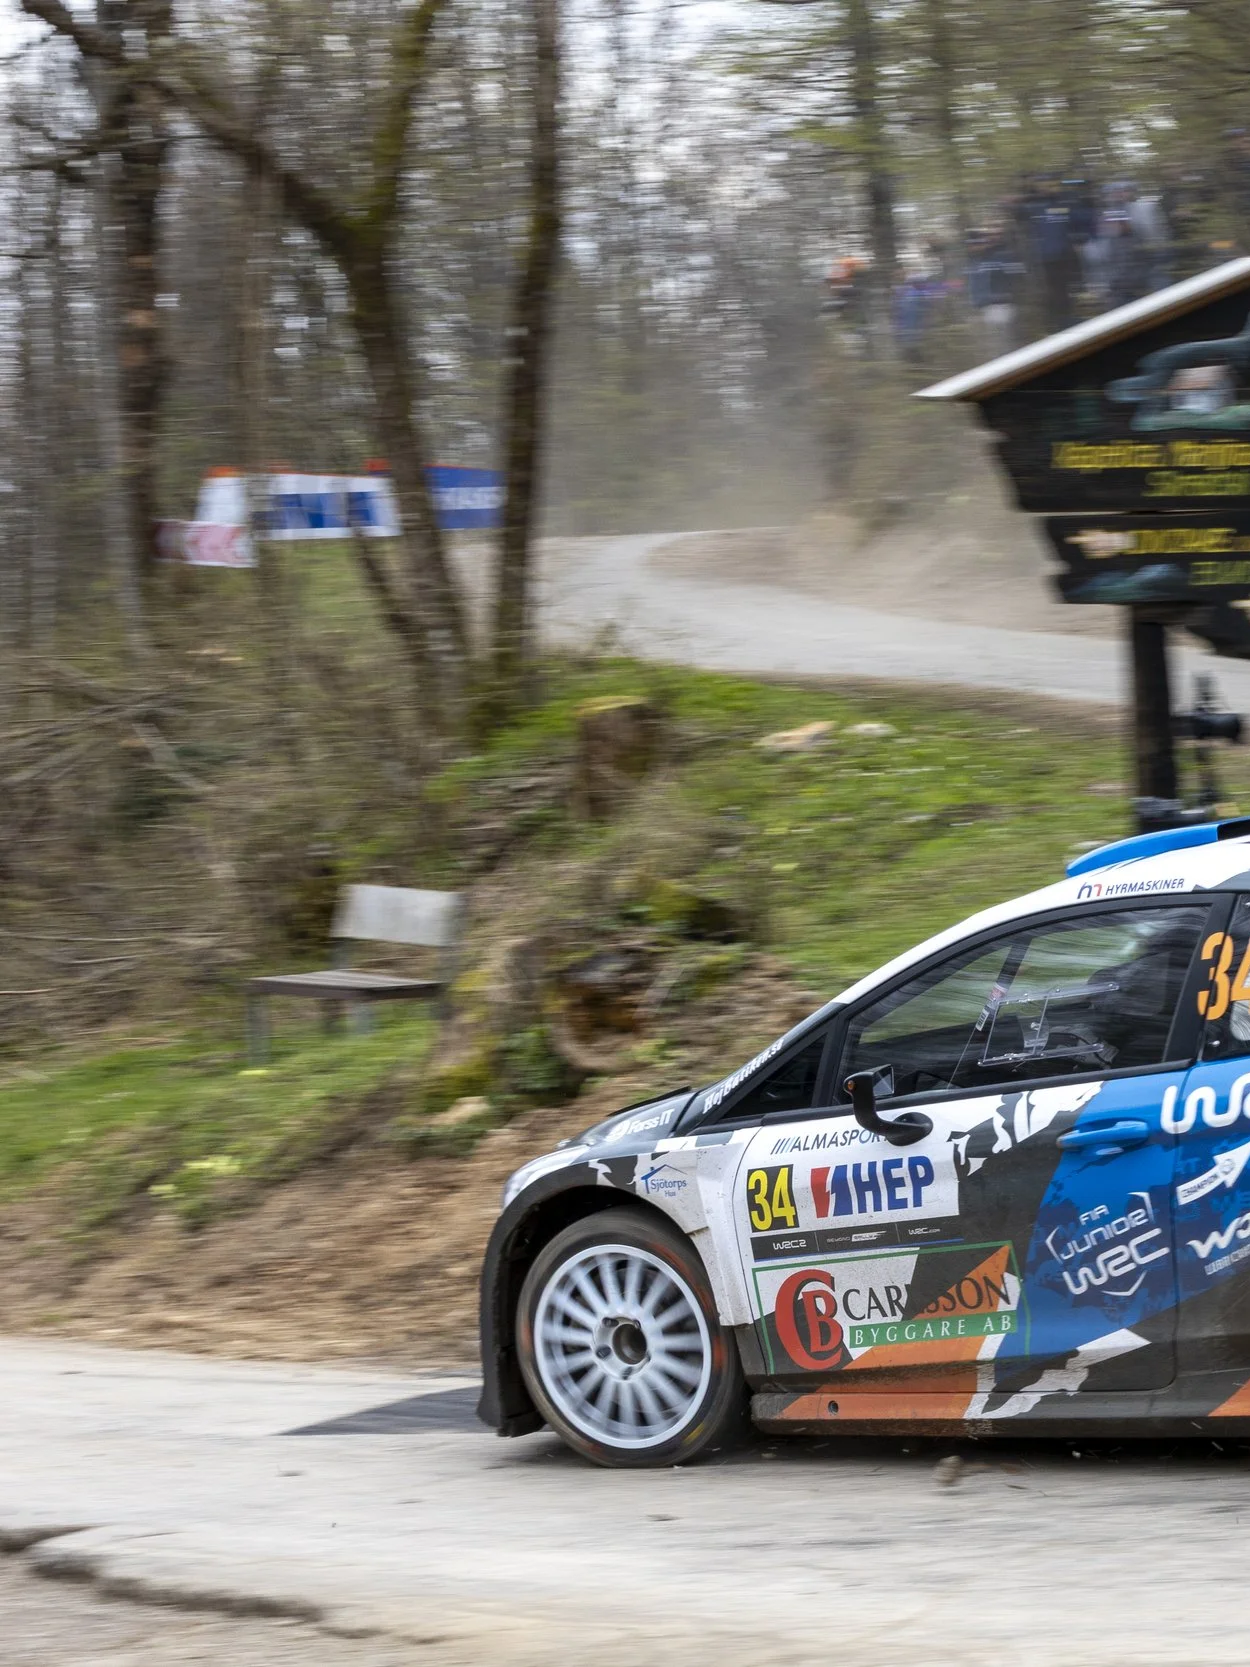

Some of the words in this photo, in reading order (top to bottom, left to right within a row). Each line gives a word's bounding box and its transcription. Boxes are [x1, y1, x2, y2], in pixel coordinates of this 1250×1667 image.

[1105, 878, 1185, 896] HYRMASKINER
[650, 1177, 687, 1192] Sjötorps
[747, 1167, 797, 1231] 34
[851, 1155, 935, 1214] HEP
[1078, 1204, 1110, 1226] FIA
[772, 1238, 808, 1251] WRC2
[1060, 1208, 1149, 1261] JUNIOR
[1062, 1227, 1171, 1295] WRC
[854, 1319, 966, 1345] BYGGARE
[983, 1314, 1012, 1332] AB
